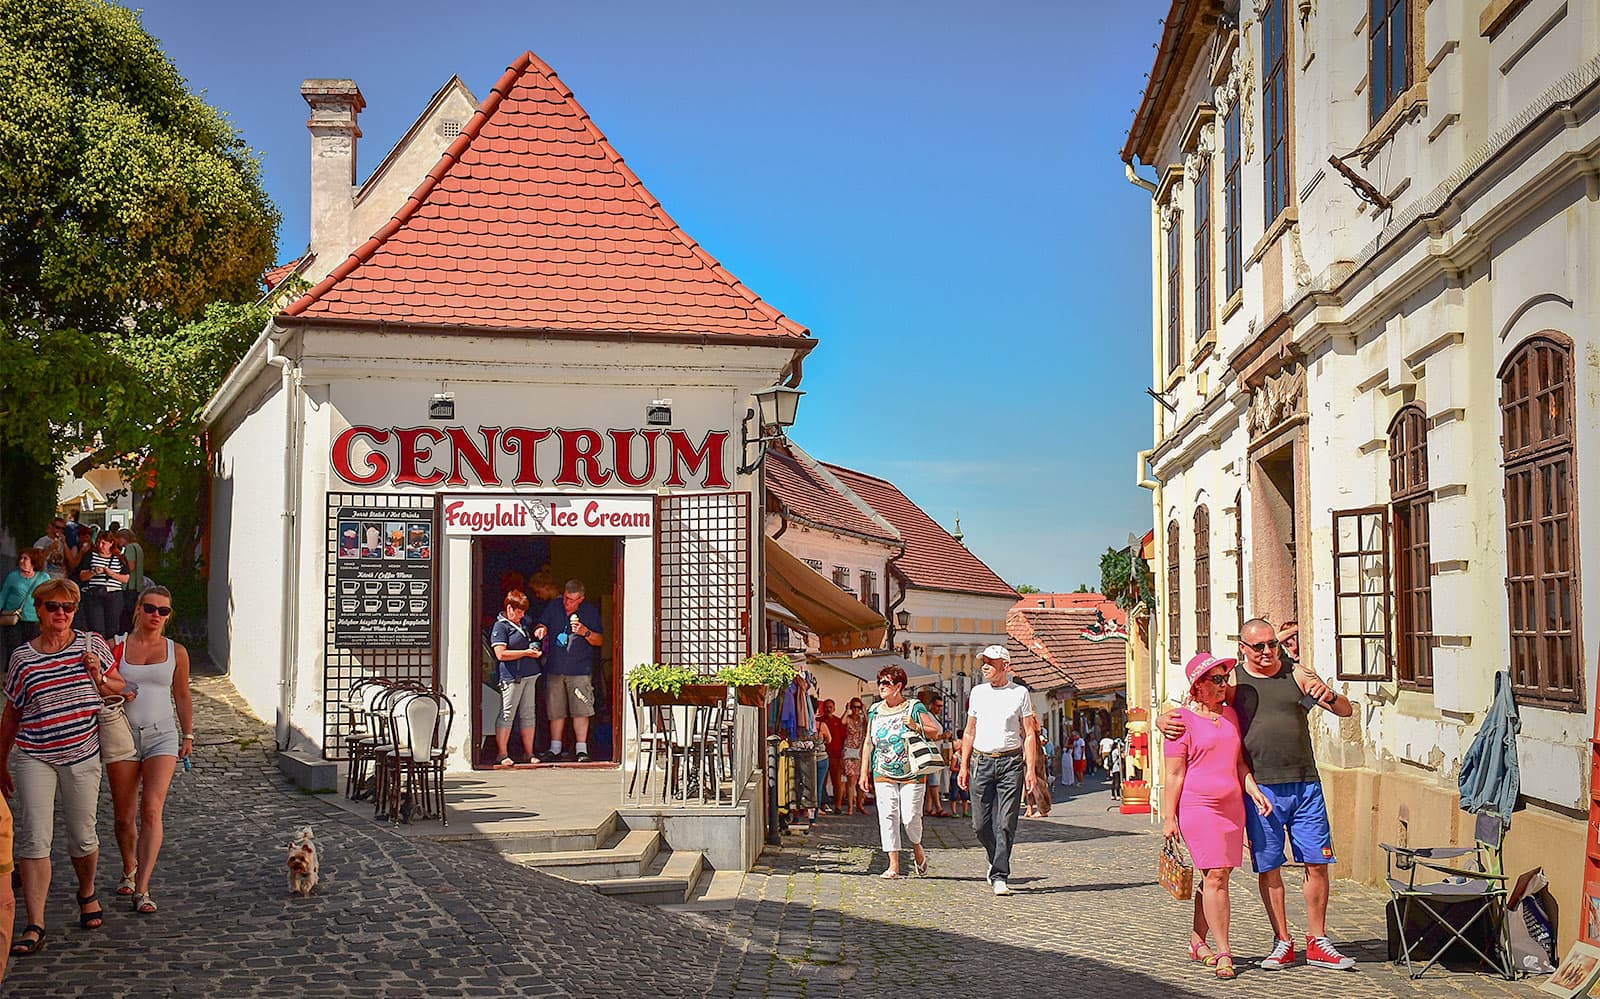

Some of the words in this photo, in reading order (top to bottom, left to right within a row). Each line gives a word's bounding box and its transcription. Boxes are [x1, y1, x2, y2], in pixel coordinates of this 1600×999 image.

[445, 501, 527, 531] Fagylalt
[550, 503, 578, 527] Ice
[584, 501, 651, 527] Cream
